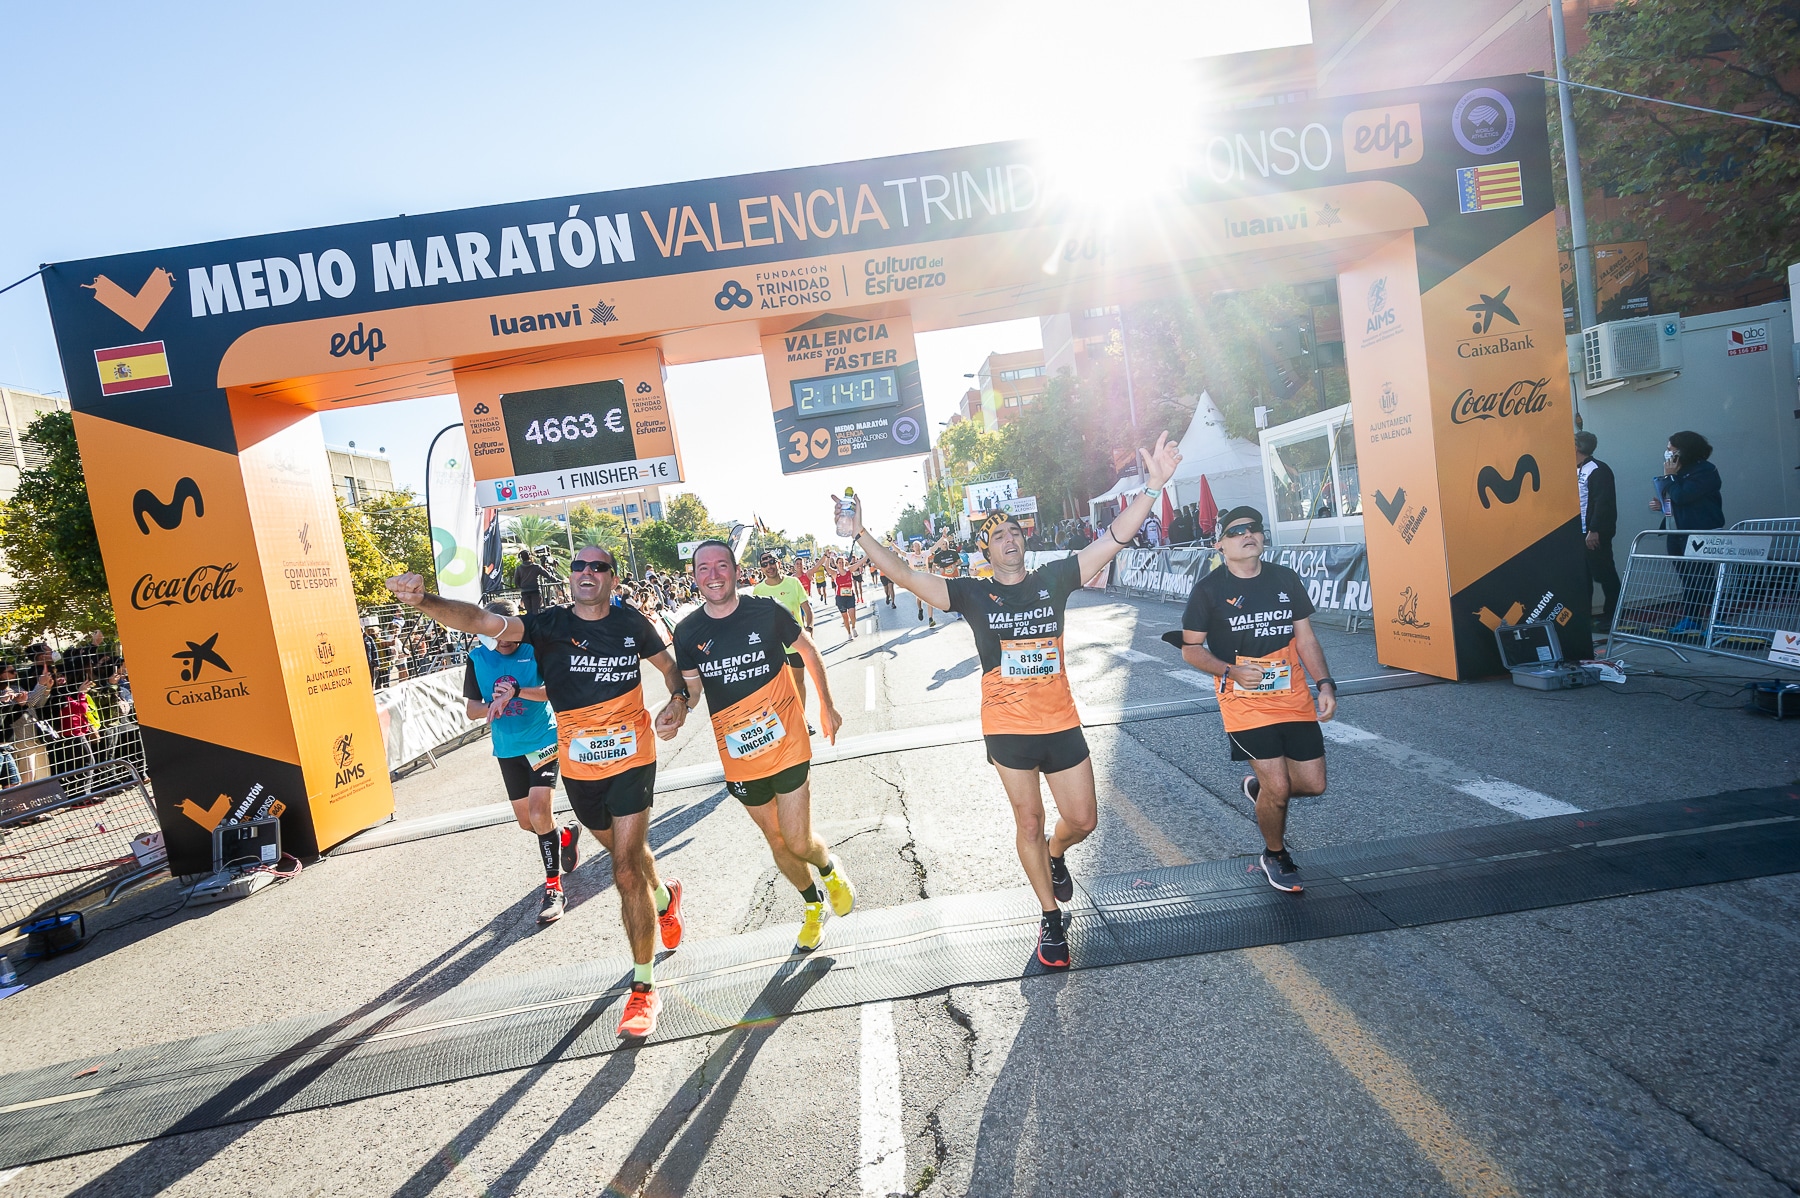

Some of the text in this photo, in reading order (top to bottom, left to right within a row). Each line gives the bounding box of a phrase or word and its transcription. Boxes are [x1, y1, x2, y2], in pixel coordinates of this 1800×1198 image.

[1354, 114, 1413, 159] edp
[1224, 206, 1308, 239] luanvi
[188, 248, 356, 318] MEDIO
[371, 204, 636, 293] MARATÓN
[641, 183, 890, 259] VALENCIA
[883, 163, 1041, 228] TRINID
[756, 264, 828, 281] FUNDACIÓN
[864, 256, 944, 277] Cultura del
[757, 276, 830, 297] TRINIDAD
[864, 272, 946, 296] Esfuerzo
[760, 290, 832, 310] ALFONSO
[489, 304, 583, 336] luanvi
[1366, 308, 1395, 334] AIMS
[785, 324, 888, 352] VALENCIA
[1744, 326, 1765, 339] abc
[330, 322, 386, 362] edp
[1457, 334, 1534, 359] CaixaBank
[787, 346, 846, 362] MAKES YOU
[825, 349, 897, 372] FASTER
[632, 399, 661, 408] TRINIDAD
[634, 404, 662, 413] ALFONSO
[1450, 377, 1552, 424] Coca-Cola
[470, 421, 500, 430] TRINIDAD
[472, 426, 501, 434] ALFONSO
[525, 408, 625, 445] 4663 €
[636, 420, 659, 428] Cultura
[636, 426, 666, 434] Esfuerzo
[834, 418, 888, 433] MEDIO MARATÓN
[1370, 414, 1412, 432] AJUNTAMENT
[835, 431, 864, 439] VALENCIA
[1370, 434, 1379, 443] DE
[474, 441, 497, 450] Cultura
[474, 447, 505, 456] Esfuerzo
[518, 484, 537, 492] paya
[557, 476, 565, 490] 1
[520, 489, 550, 499] sospital
[1401, 514, 1416, 539] CIUDAD
[1405, 505, 1428, 545] DEL RUNNING
[284, 568, 331, 578] COMUNITAT
[131, 562, 243, 610] Coca-Cola
[290, 578, 338, 589] DE L'ESPORT
[988, 606, 1054, 623] VALENCIA
[1526, 590, 1554, 624] MARATÓN
[1229, 610, 1292, 626] VALENCIA
[1013, 622, 1058, 636] FASTER
[1232, 623, 1254, 631] MAKES
[570, 655, 638, 667] VALENCIA
[698, 650, 765, 672] VALENCIA
[1020, 653, 1042, 663] 8139
[306, 666, 351, 683] AJUNTAMENT
[724, 664, 770, 684] FASTER
[1009, 665, 1054, 675] Davidiego
[166, 682, 250, 706] CaixaBank
[308, 686, 319, 696] DE
[740, 726, 763, 742] 8239
[590, 739, 615, 749] 8238
[737, 731, 775, 755] VINCENT
[579, 748, 627, 762] NOGUERA
[335, 763, 365, 789] AIMS
[234, 782, 264, 819] MARATÓN
